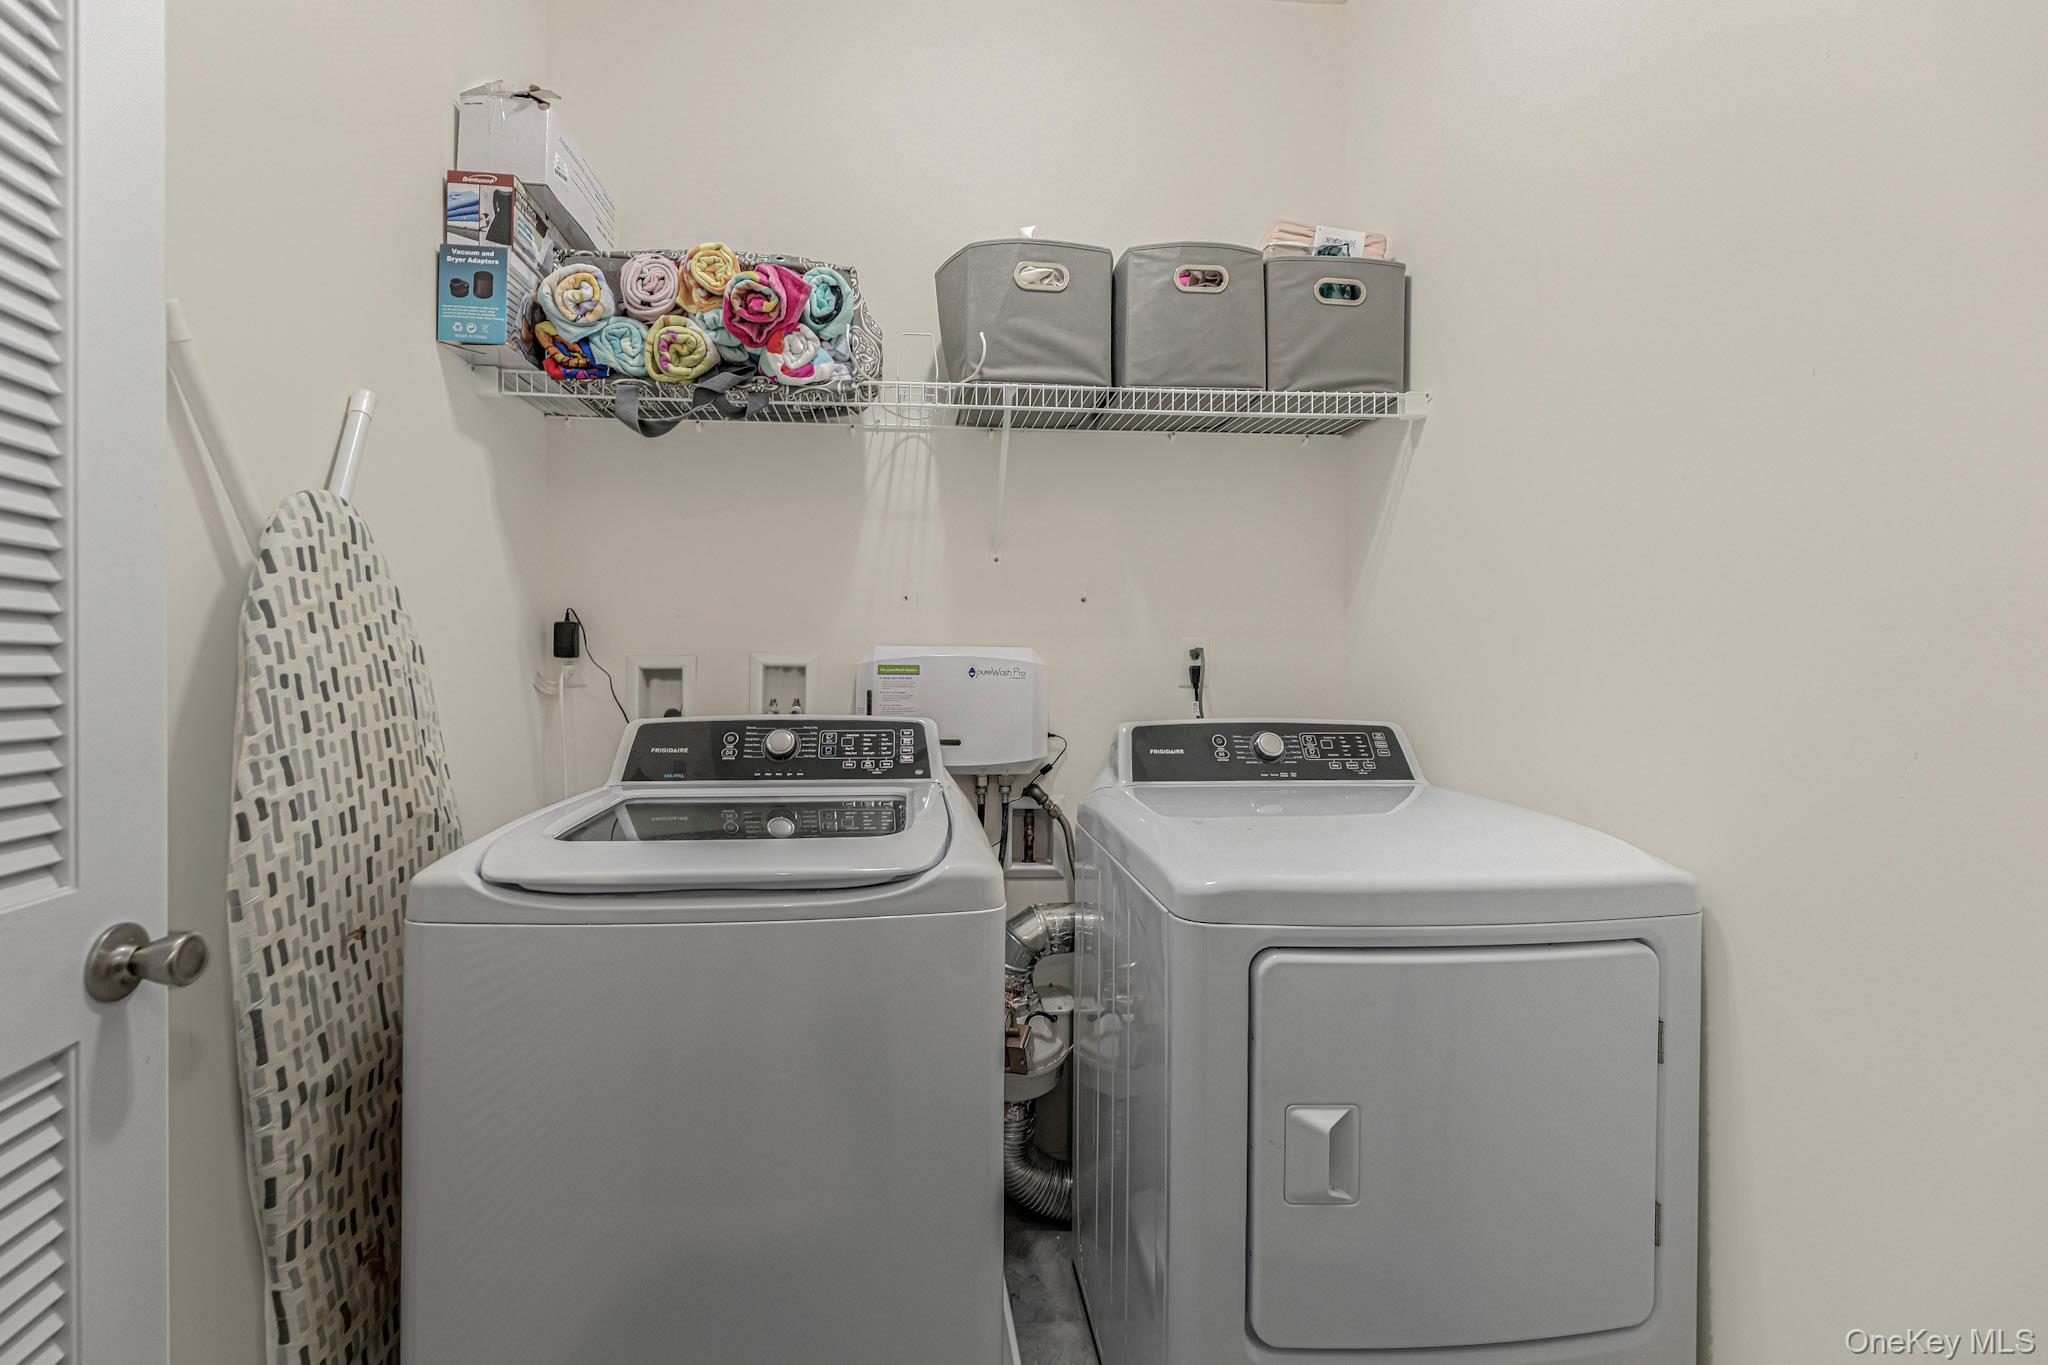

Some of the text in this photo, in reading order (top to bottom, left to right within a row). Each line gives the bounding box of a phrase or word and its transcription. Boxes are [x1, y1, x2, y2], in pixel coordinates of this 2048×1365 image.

[451, 247, 495, 257] Vacuum and
[446, 256, 466, 264] Dryer
[1013, 667, 1027, 676] Pro
